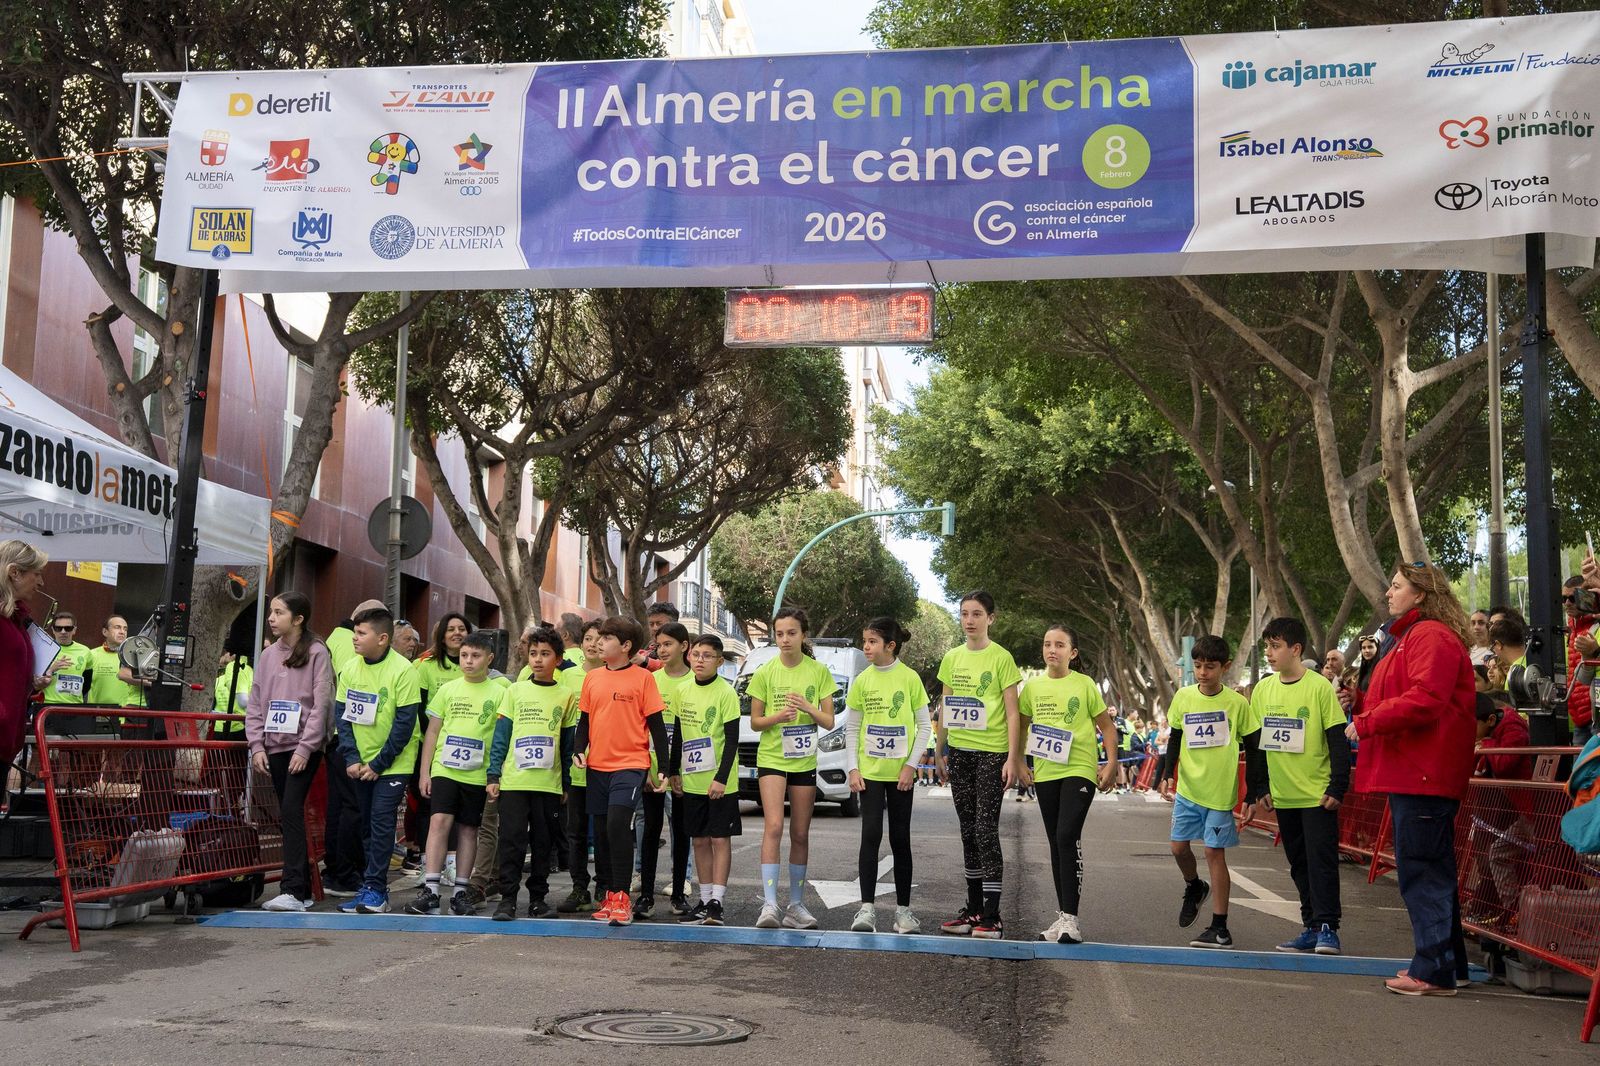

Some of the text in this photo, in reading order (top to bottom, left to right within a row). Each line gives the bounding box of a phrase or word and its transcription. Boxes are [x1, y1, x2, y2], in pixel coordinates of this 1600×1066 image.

[1264, 59, 1377, 88] cajamar
[1426, 63, 1515, 78] MICHELIN
[1319, 77, 1375, 88] CAJA RURAL
[256, 92, 332, 115] deretil
[557, 65, 1152, 129] II Almería en marcha
[1497, 110, 1592, 122] FUNDACIÓN
[1497, 120, 1595, 145] primaflor
[1104, 135, 1129, 168] 8
[1219, 137, 1373, 158] Isabel Alonso
[577, 136, 1059, 192] contra el cáncer
[185, 170, 234, 182] ALMERÍA
[478, 176, 499, 184] 2005
[1100, 170, 1131, 179] Febrero
[304, 185, 316, 193] DE
[1490, 175, 1550, 191] Toyota
[1024, 197, 1153, 213] asociación española
[1235, 190, 1366, 216] LEALTADIS
[1491, 190, 1557, 208] Alborán
[1026, 212, 1127, 226] contra el cáncer
[1262, 214, 1336, 226] ABOGADOS
[416, 225, 506, 238] UNIVERSIDAD
[803, 210, 887, 242] 2026
[198, 230, 246, 242] DE CABRAS
[572, 226, 742, 243] #TodosContraElCáncer
[1026, 228, 1098, 241] en Almería
[415, 237, 504, 250] DE ALMERÍA
[278, 249, 313, 257] Compañía
[61, 681, 80, 691] 313
[350, 702, 364, 715] 39
[951, 708, 979, 721] 719
[271, 712, 287, 724] 40
[1195, 724, 1216, 738] 44
[1272, 729, 1291, 743] 45
[794, 736, 811, 749] 35
[876, 737, 895, 750] 34
[1036, 736, 1063, 754] 716
[451, 747, 471, 761] 43
[525, 747, 544, 760] 38
[688, 751, 703, 763] 42
